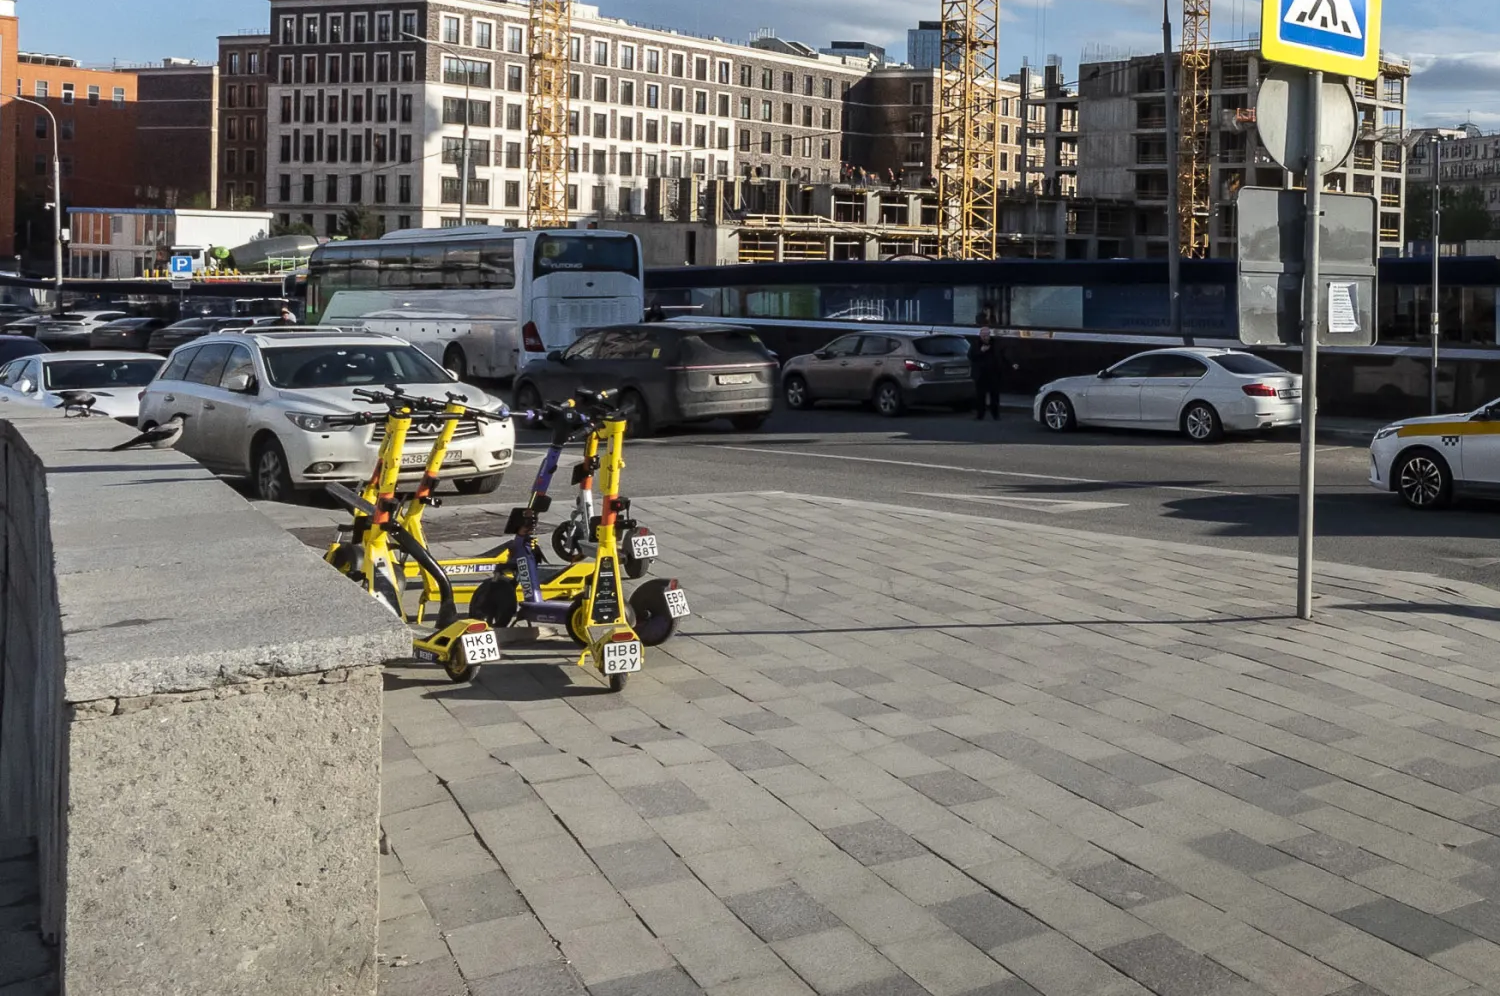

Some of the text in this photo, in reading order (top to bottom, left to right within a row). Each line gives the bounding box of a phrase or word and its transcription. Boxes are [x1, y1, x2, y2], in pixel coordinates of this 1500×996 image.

[176, 258, 188, 271] P
[633, 537, 655, 548] КА2
[666, 591, 684, 604] ЕВ9
[465, 634, 494, 647] НК8
[469, 647, 497, 661] 23М
[607, 644, 638, 657] НВ8
